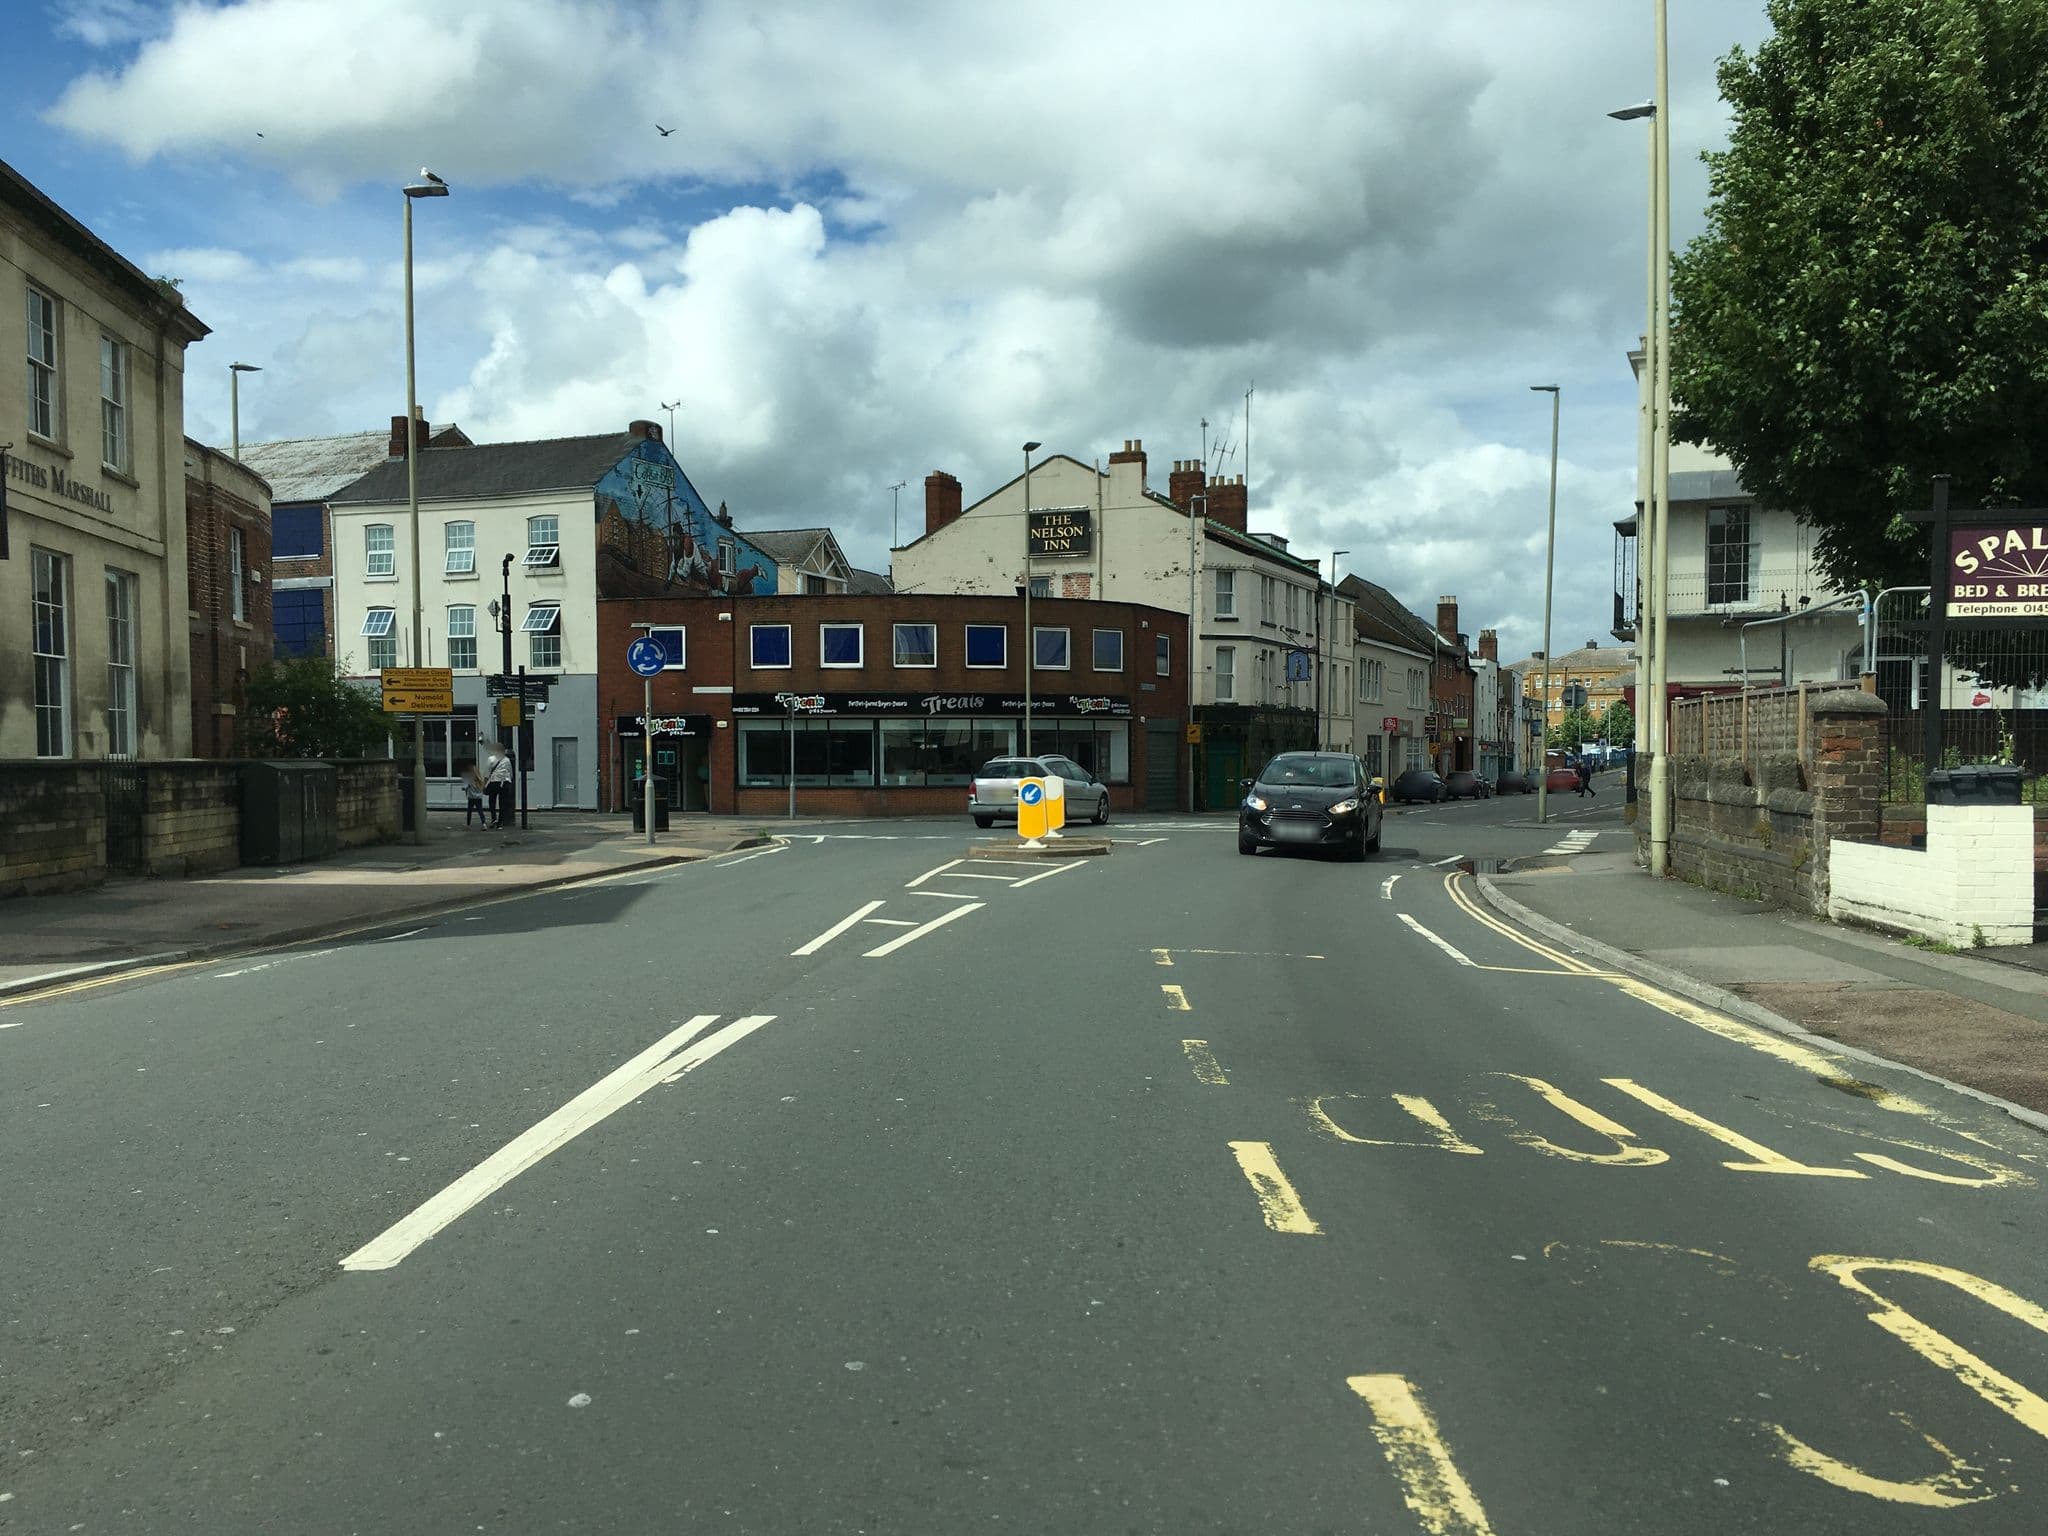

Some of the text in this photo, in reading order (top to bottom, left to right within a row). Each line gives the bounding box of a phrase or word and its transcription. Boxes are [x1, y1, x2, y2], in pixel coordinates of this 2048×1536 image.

[51, 465, 114, 513] MARSHALL
[1042, 514, 1072, 525] THE
[1031, 526, 1084, 538] NELSON
[1044, 539, 1070, 550] INN
[1954, 584, 1988, 597] BED
[1995, 584, 2009, 597] &
[1957, 604, 2017, 615] Telephone
[921, 694, 985, 715] Treats
